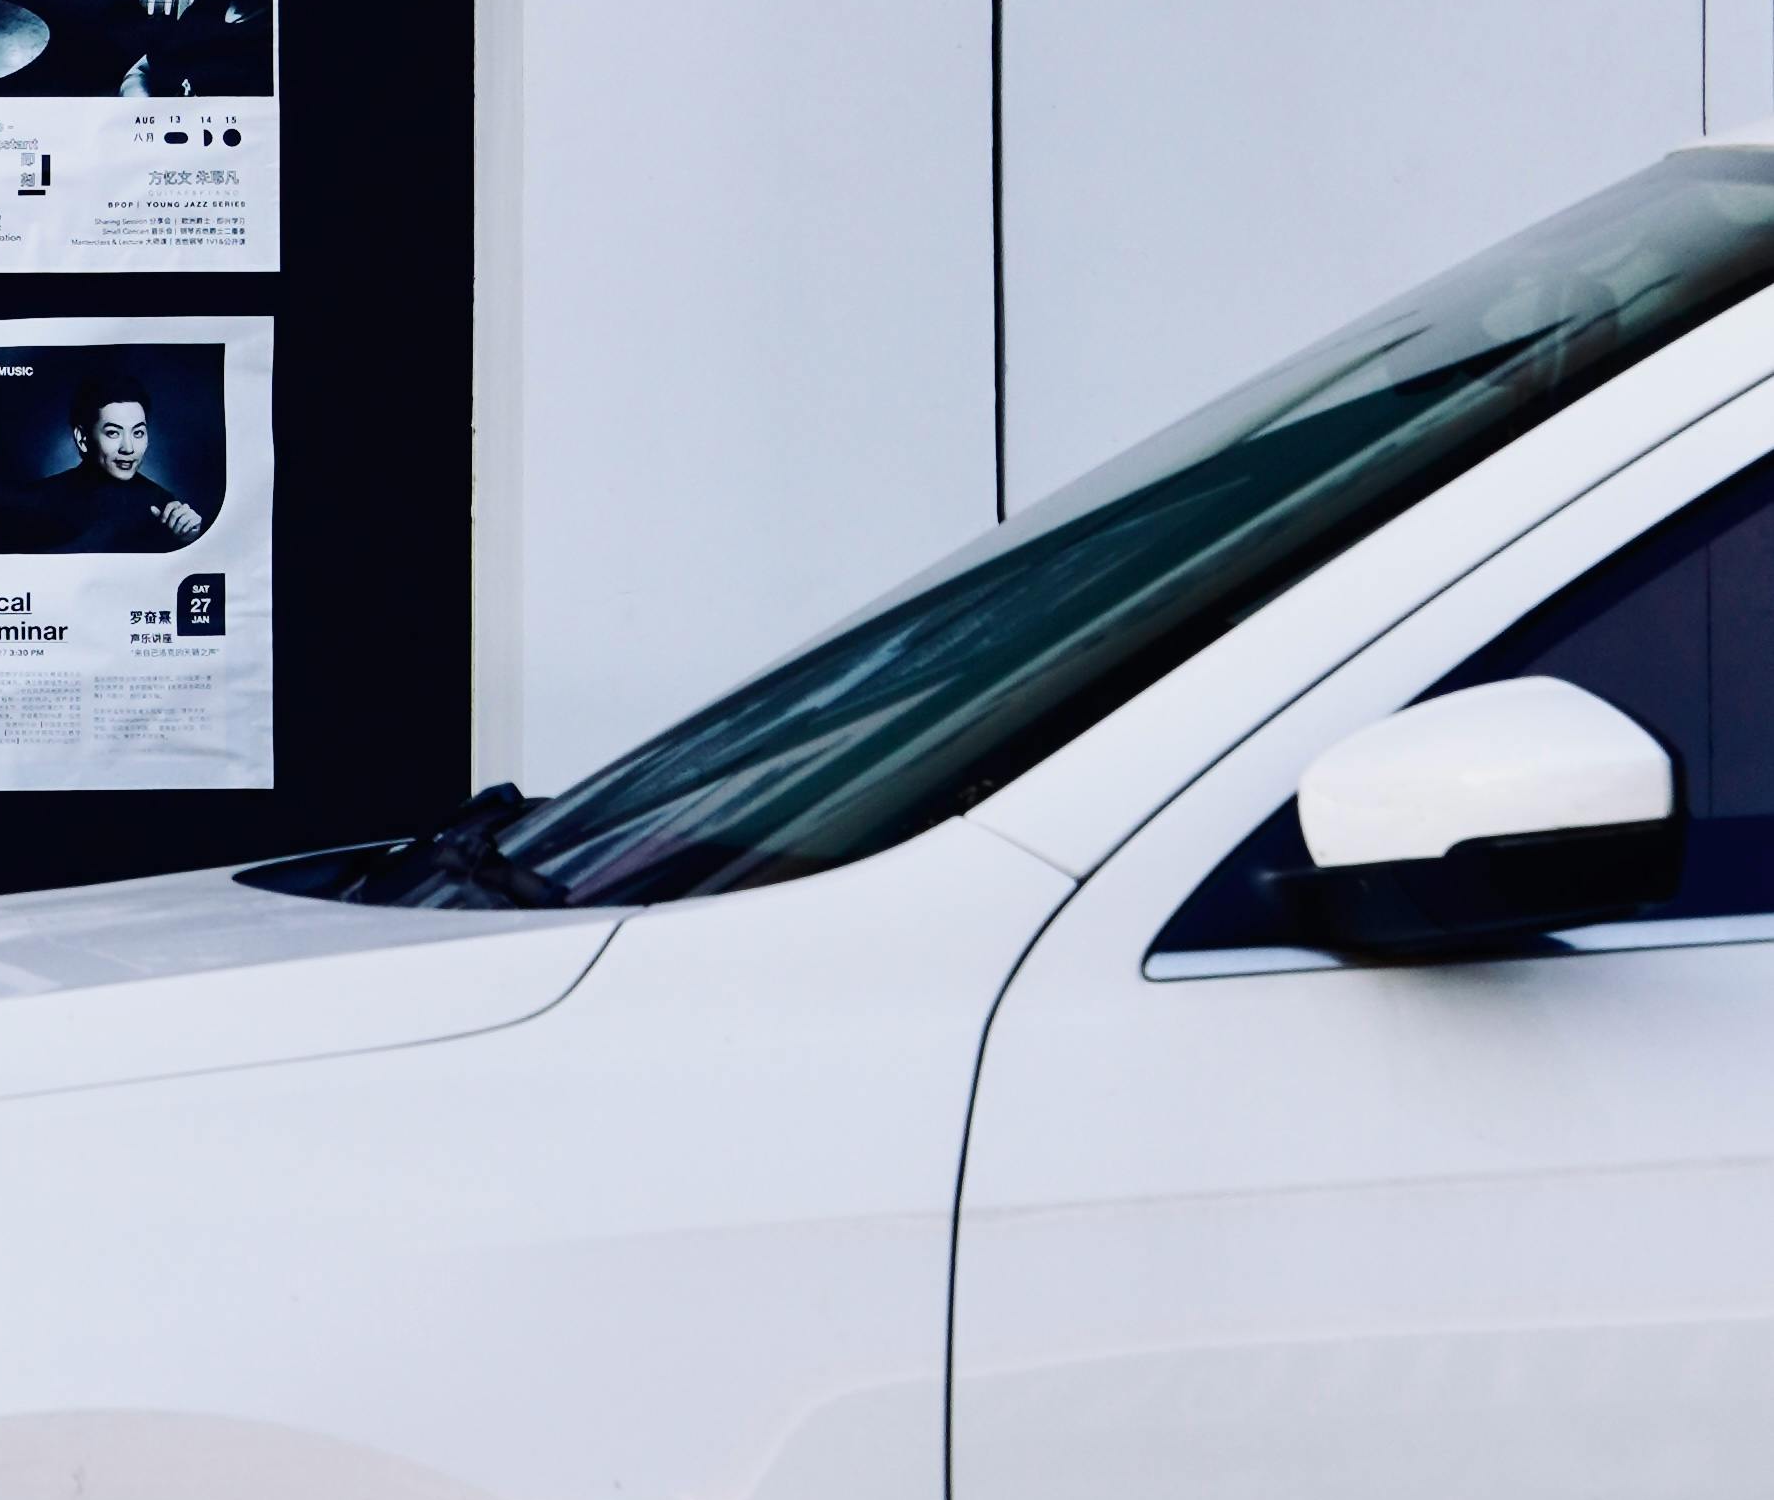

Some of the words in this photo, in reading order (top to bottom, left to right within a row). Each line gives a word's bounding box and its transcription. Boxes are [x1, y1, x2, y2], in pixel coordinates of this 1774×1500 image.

[135, 116, 155, 124] AUG
[170, 115, 181, 123] 13
[134, 132, 154, 142] 八月
[192, 585, 211, 593] SAT
[191, 598, 211, 612] 27
[192, 615, 210, 624] JAN
